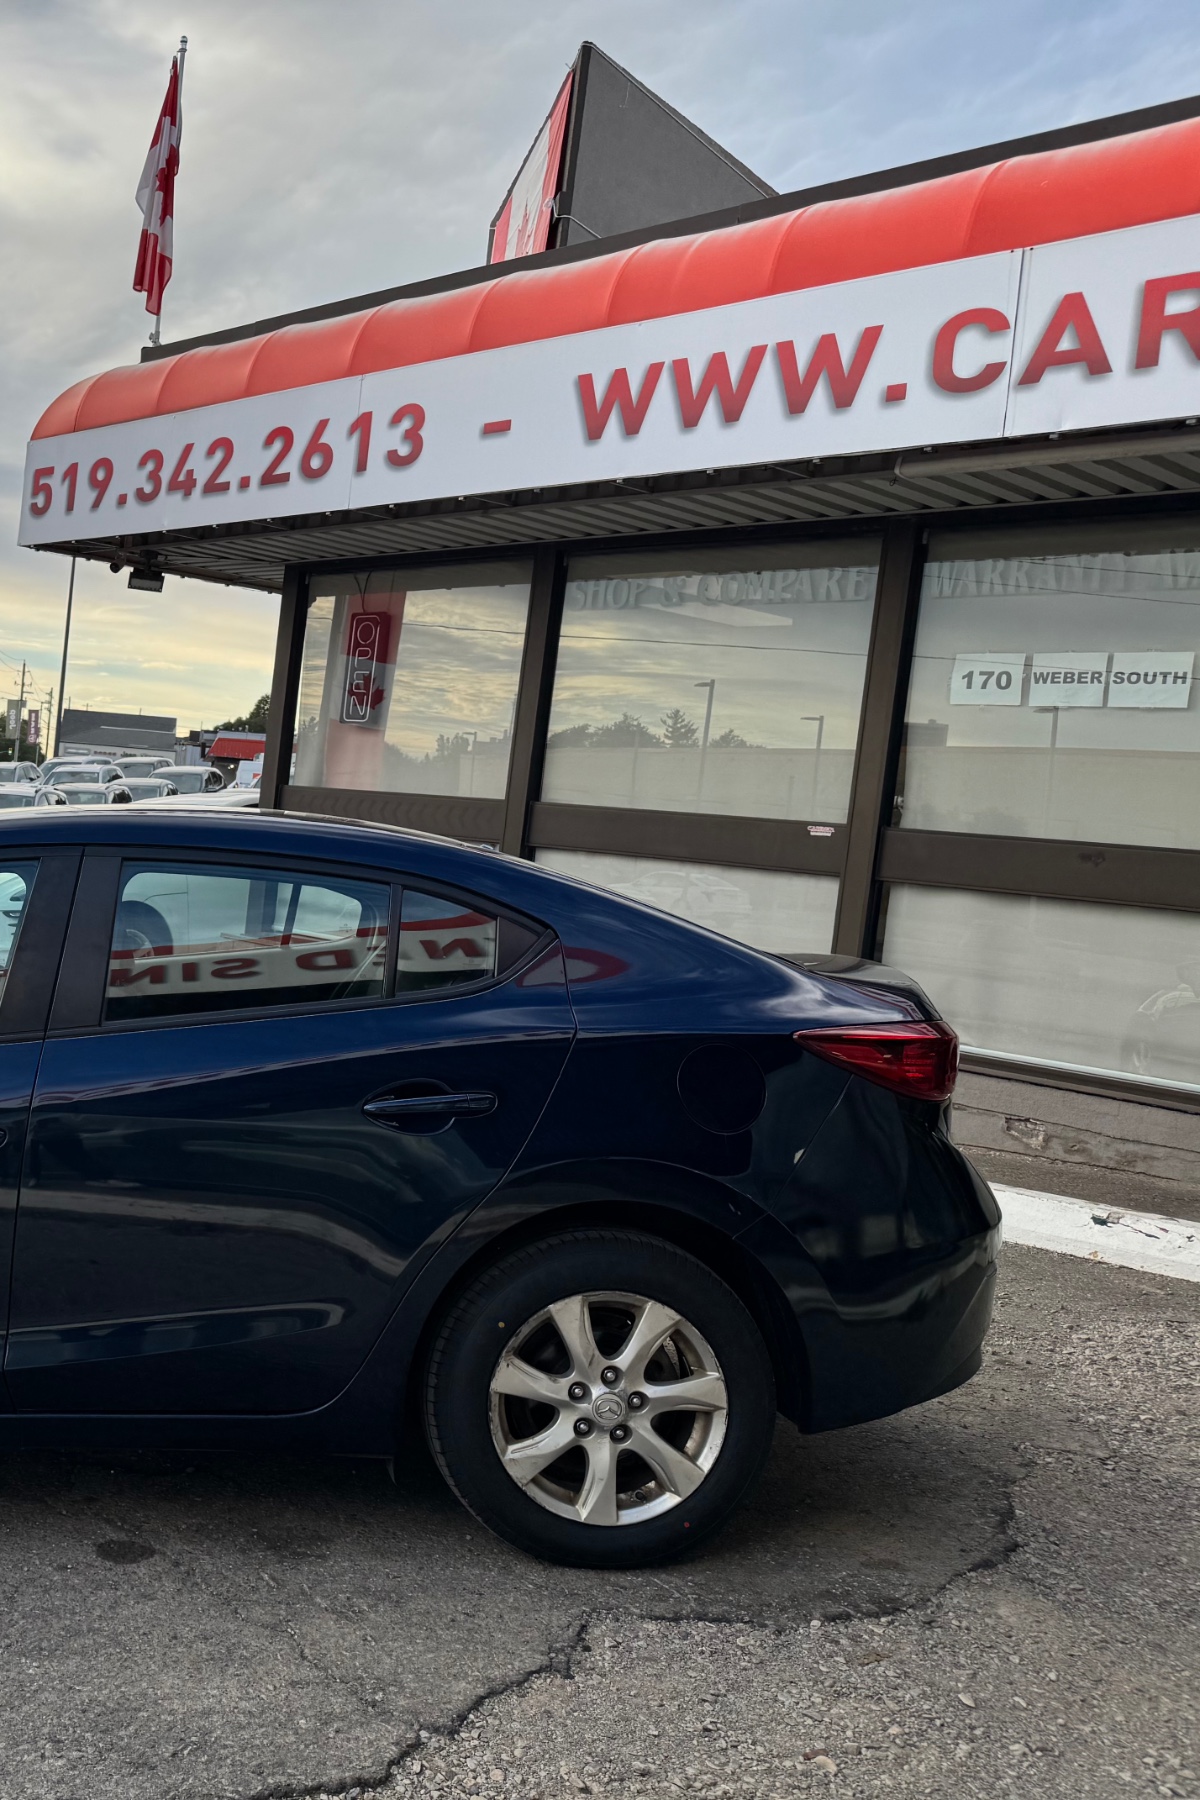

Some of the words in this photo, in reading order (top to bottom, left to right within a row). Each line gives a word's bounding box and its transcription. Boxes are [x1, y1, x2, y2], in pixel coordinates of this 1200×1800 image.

[30, 403, 426, 516] 519.342.2613
[577, 271, 1200, 441] WWW.CAR
[572, 578, 648, 610] SHOP
[697, 566, 869, 605] COMPARE
[350, 621, 375, 716] OPEN
[961, 670, 1013, 690] 170
[1033, 671, 1103, 684] WEBER
[1112, 671, 1188, 685] SOUTH
